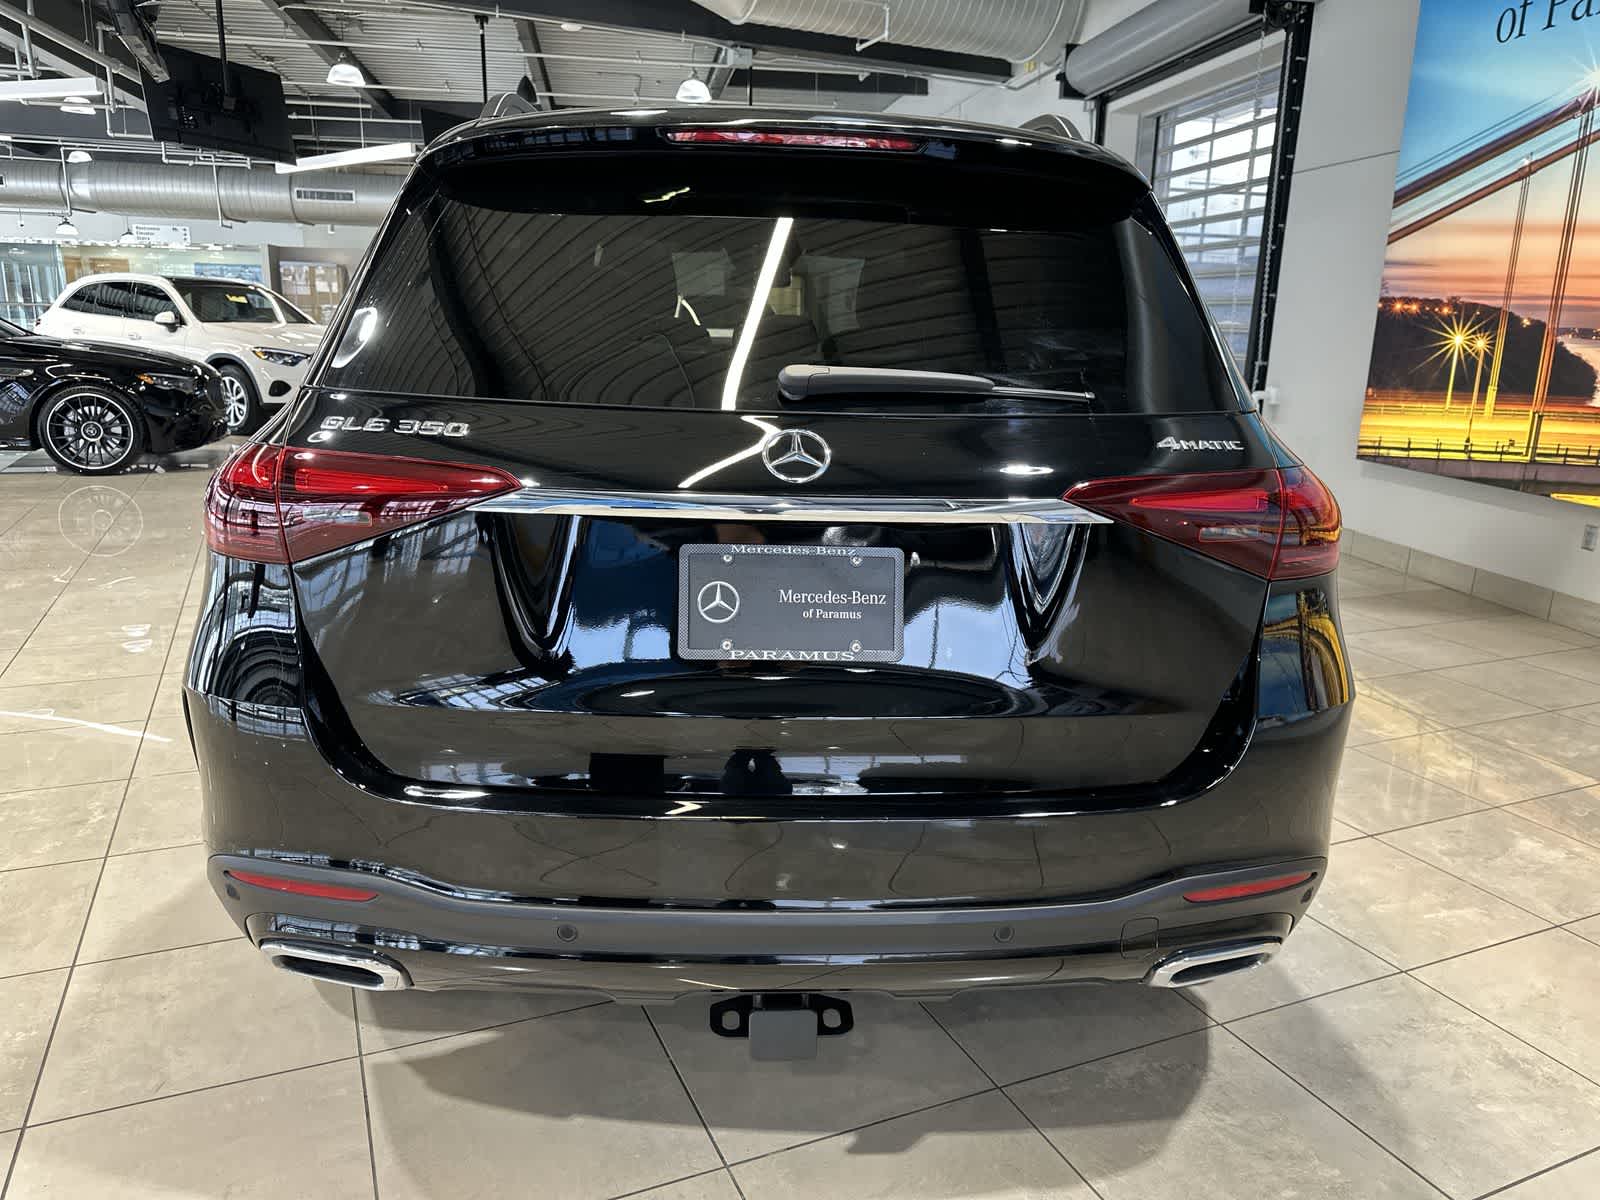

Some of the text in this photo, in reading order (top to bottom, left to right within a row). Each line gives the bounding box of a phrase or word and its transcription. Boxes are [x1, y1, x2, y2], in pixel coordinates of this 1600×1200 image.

[1541, 0, 1600, 31] Pa
[320, 416, 470, 437] GLE 350
[1156, 436, 1245, 451] 4MATIC
[731, 545, 857, 556] Mercedes-Benz
[778, 589, 887, 605] Mercedes-Benz
[802, 608, 862, 619] of Paramus
[730, 650, 855, 661] PARAMUS
